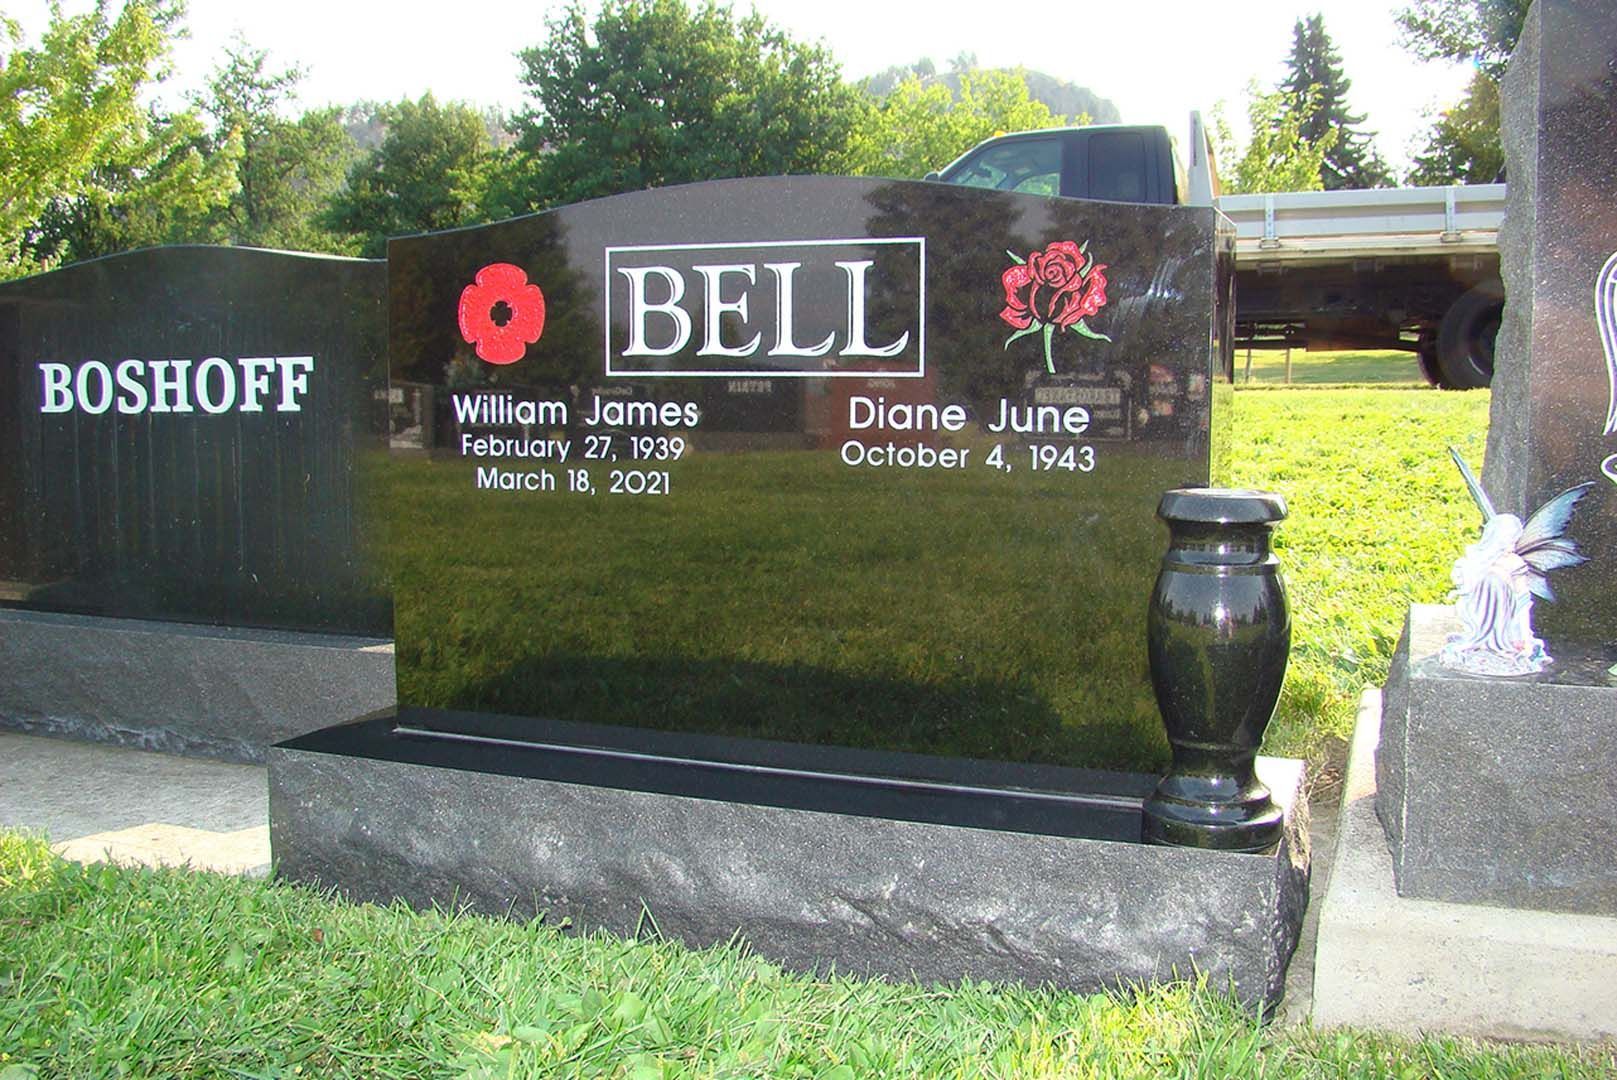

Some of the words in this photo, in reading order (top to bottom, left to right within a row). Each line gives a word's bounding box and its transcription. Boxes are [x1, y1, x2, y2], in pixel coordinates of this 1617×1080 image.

[617, 259, 910, 358] BELL
[38, 356, 315, 415] BOSHOFF
[452, 394, 568, 426] William
[584, 395, 701, 428] James
[848, 396, 967, 431] Diane
[987, 398, 1091, 434] June
[461, 433, 571, 463] February
[584, 435, 618, 463] 27,
[630, 436, 686, 462] 1939
[840, 440, 970, 469] October
[985, 443, 1012, 473] 4,
[1029, 444, 1096, 473] 1943
[476, 466, 556, 491] March
[567, 468, 597, 496] 18,
[609, 469, 671, 495] 2021
